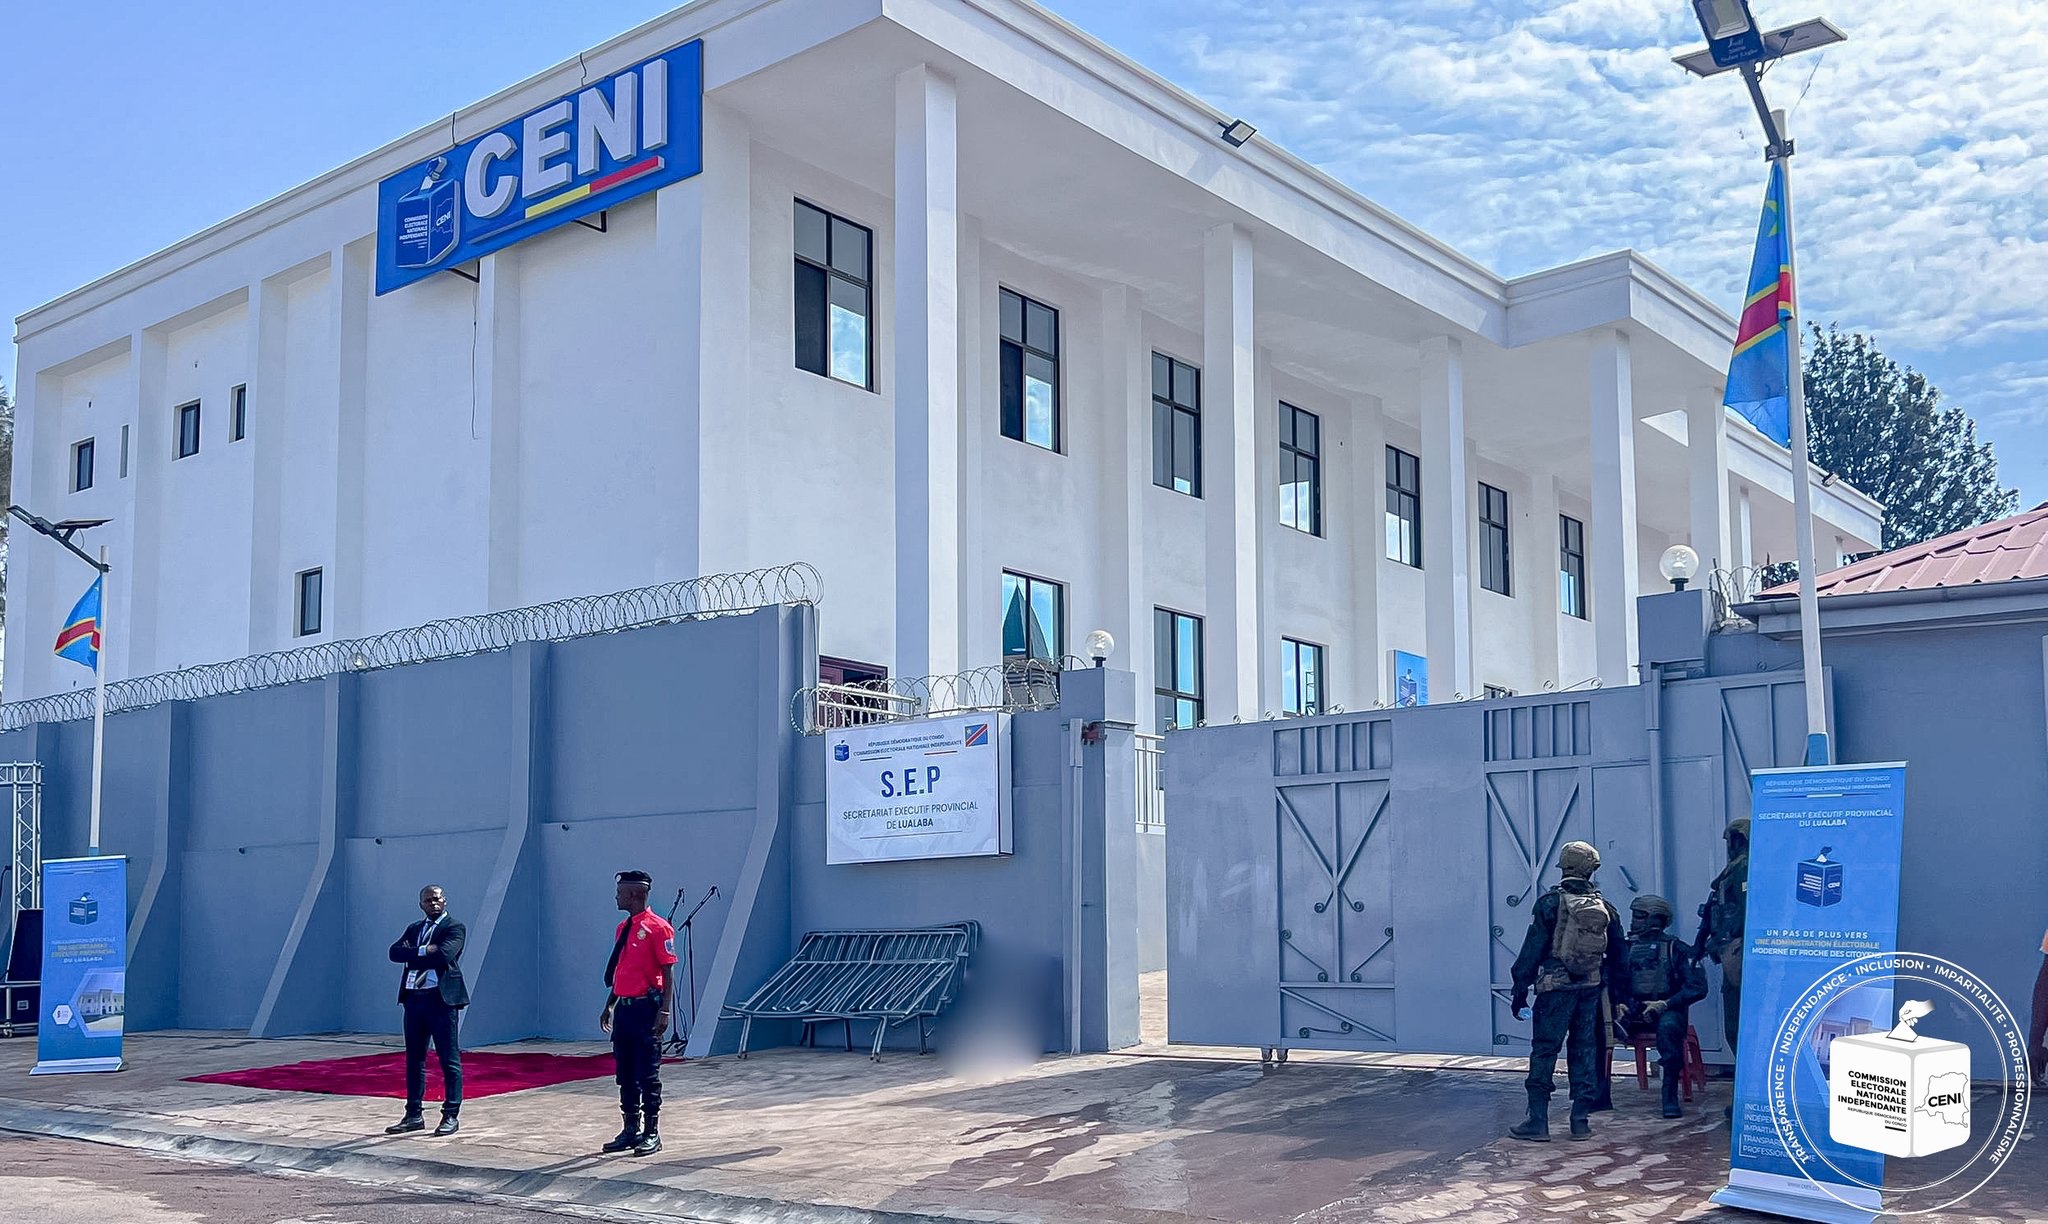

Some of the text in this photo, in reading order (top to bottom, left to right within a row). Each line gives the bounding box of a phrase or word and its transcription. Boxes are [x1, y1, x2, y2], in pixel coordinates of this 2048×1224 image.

[465, 59, 667, 218] CENI
[881, 766, 940, 798] S.E.P
[843, 801, 978, 820] SECRETARIAT EXECUTIF PROVINCIAL
[1845, 808, 1893, 818] PROVINCIAL
[887, 818, 934, 829] DE LUALABA
[1812, 818, 1847, 827] LUALABA
[1782, 929, 1800, 937] PAS
[1803, 930, 1814, 938] DE
[1818, 930, 1842, 938] PLUS
[1844, 931, 1868, 939] VERS
[1770, 939, 1832, 948] ADMINISTRATION
[1752, 947, 1788, 955] MODERNE
[1799, 949, 1829, 957] PROCHE
[1830, 950, 1844, 958] DES
